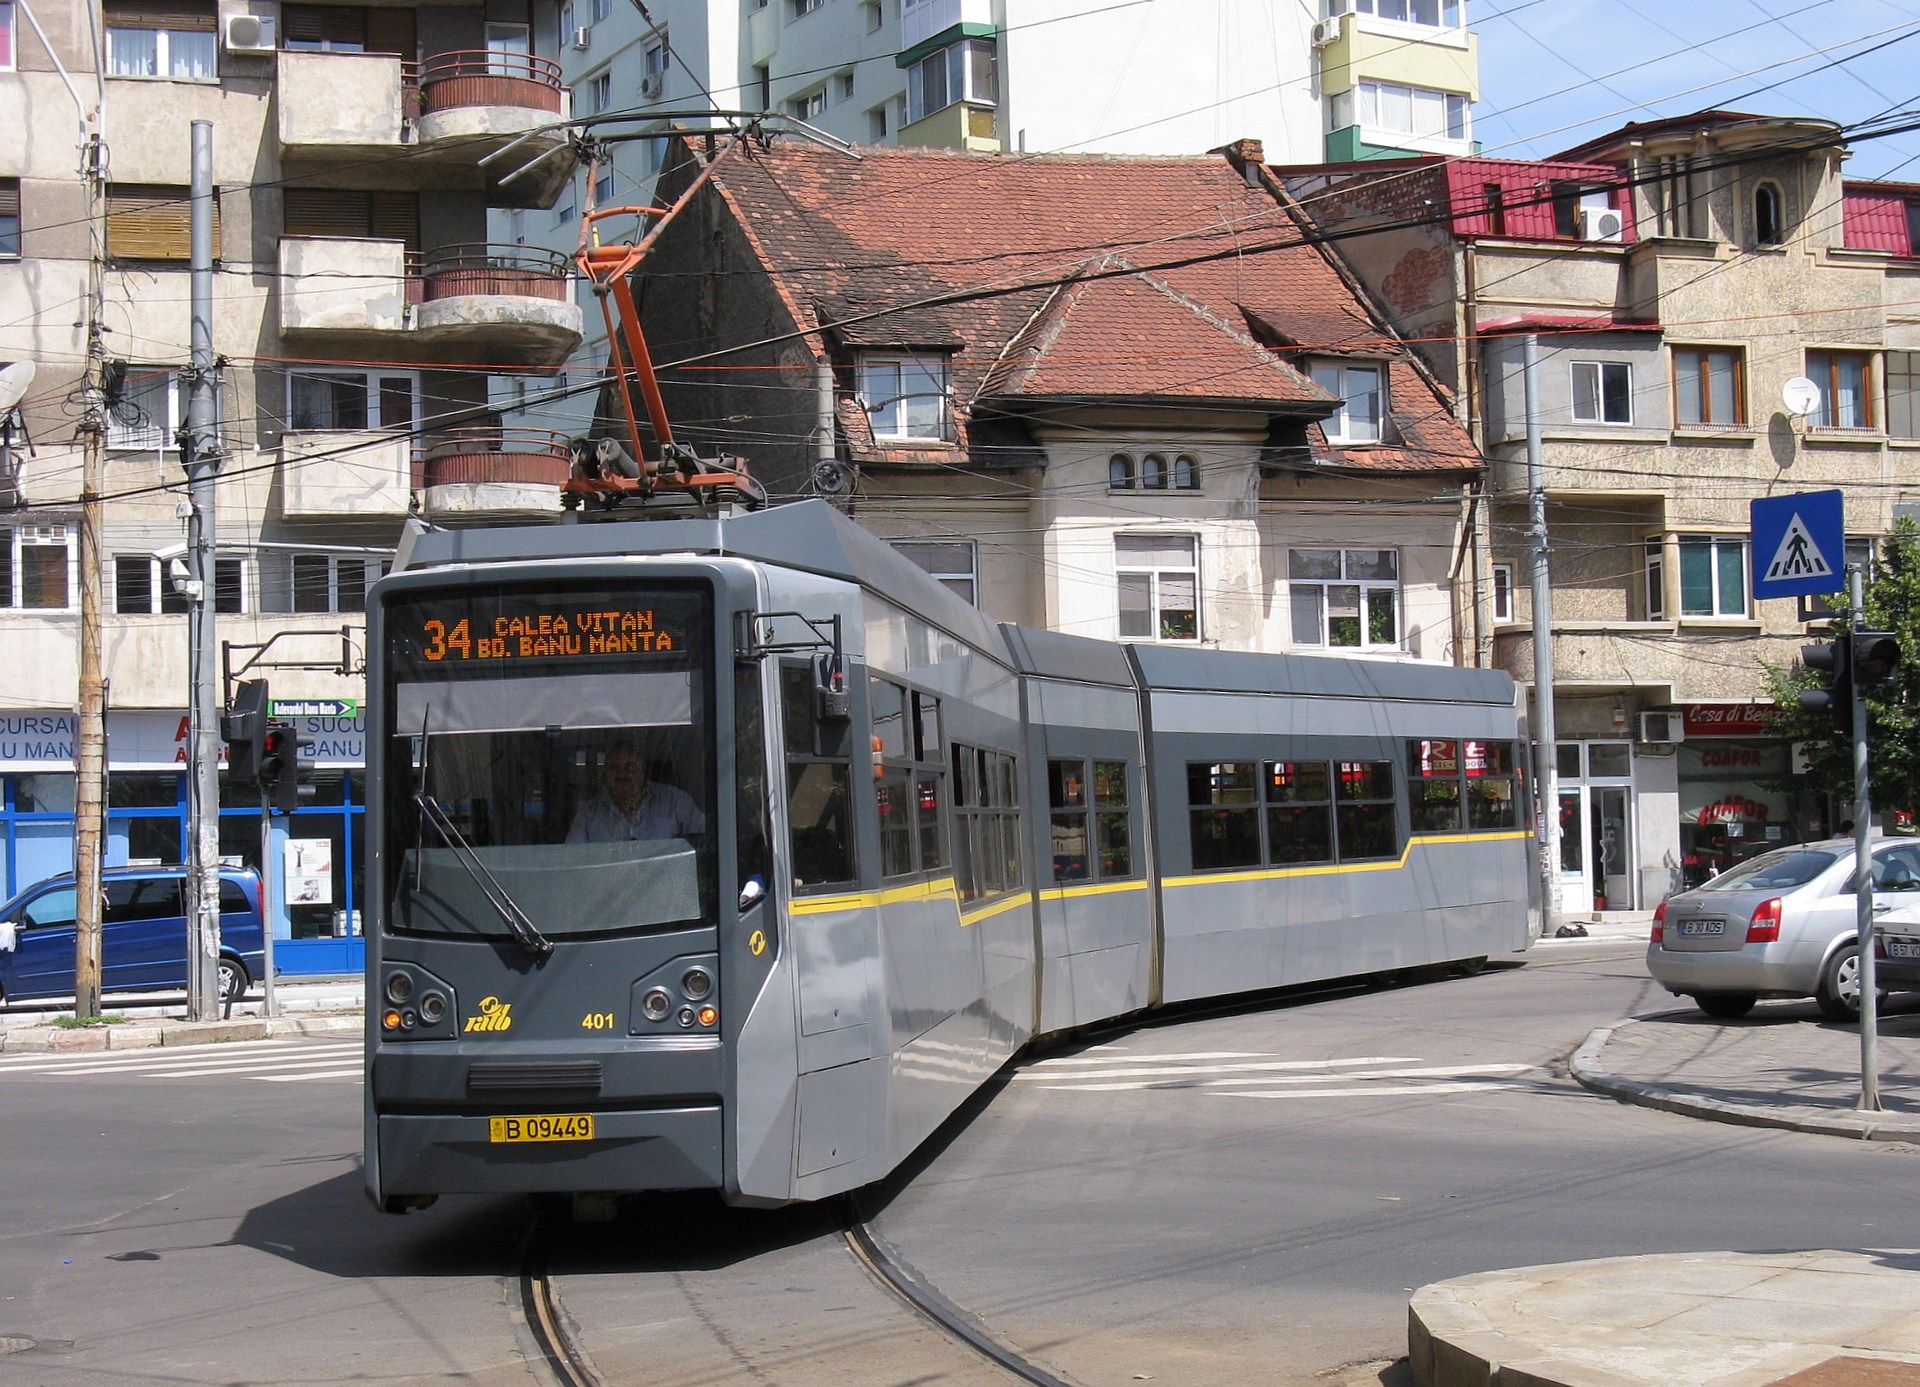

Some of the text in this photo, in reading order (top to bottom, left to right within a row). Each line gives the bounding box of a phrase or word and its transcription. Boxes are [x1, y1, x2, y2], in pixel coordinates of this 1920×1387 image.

[494, 610, 653, 637] CALEA VITAN
[423, 618, 471, 661] 34
[477, 631, 672, 658] BD. BANU MANTA
[304, 740, 362, 757] BANU
[1687, 922, 1693, 933] B
[581, 1013, 615, 1030] 401
[506, 1117, 590, 1139] B 09449
